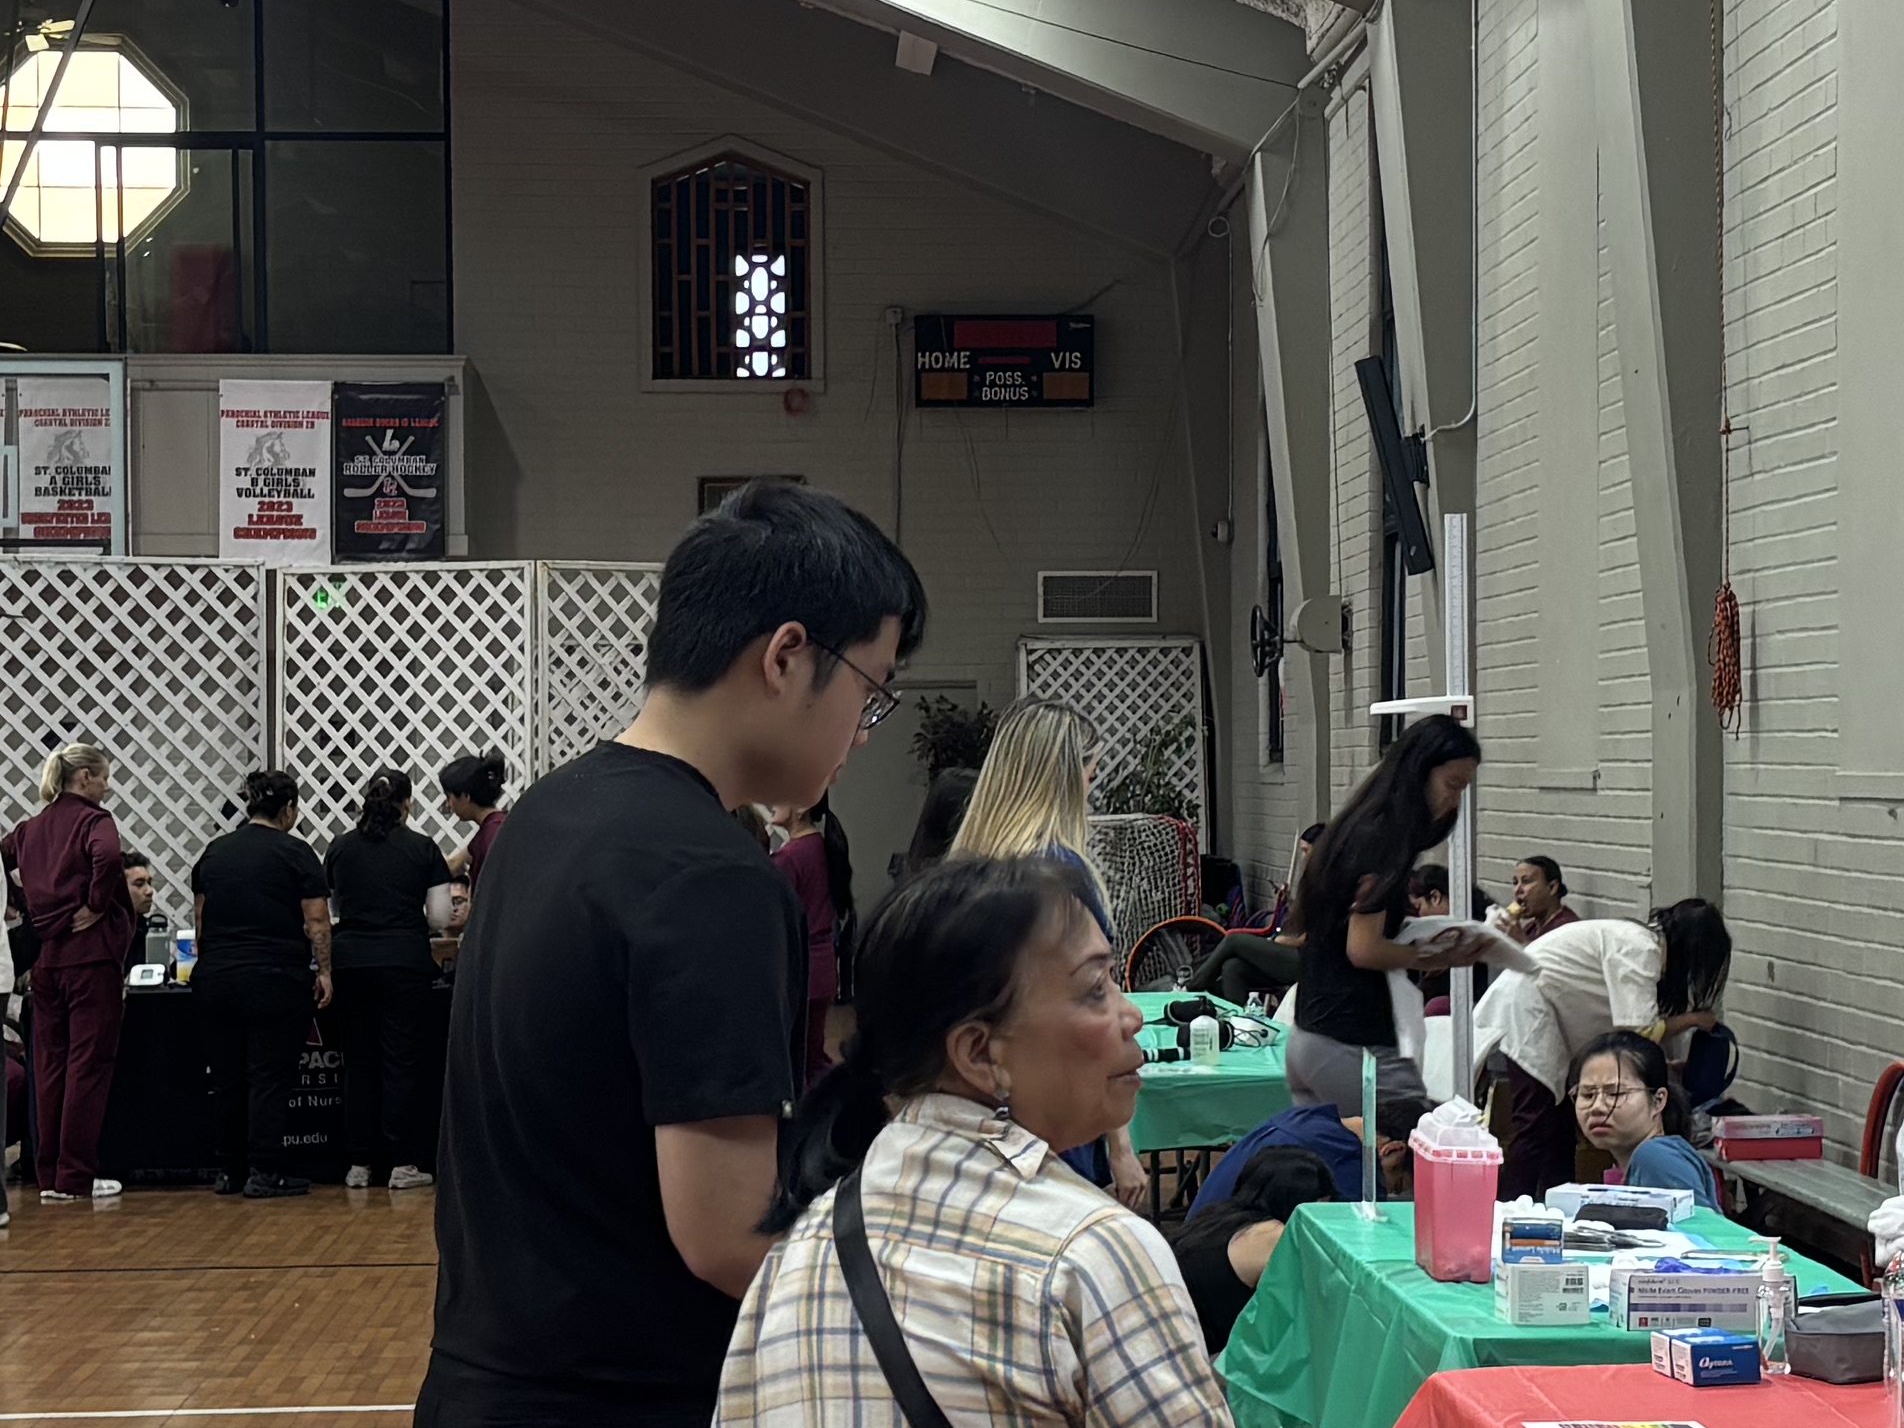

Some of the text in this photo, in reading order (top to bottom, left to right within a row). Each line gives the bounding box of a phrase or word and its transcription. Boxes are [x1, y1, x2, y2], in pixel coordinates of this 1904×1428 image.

[917, 351, 1082, 369] HOME VIS
[986, 372, 1026, 385] POSS.
[982, 387, 1029, 401] BONUS
[34, 466, 51, 476] ST.
[235, 467, 316, 477] ST. COLUMBAN
[49, 476, 101, 486] A GIRLS
[263, 478, 300, 488] GIRLS
[236, 488, 315, 499] VOLLEYBALL
